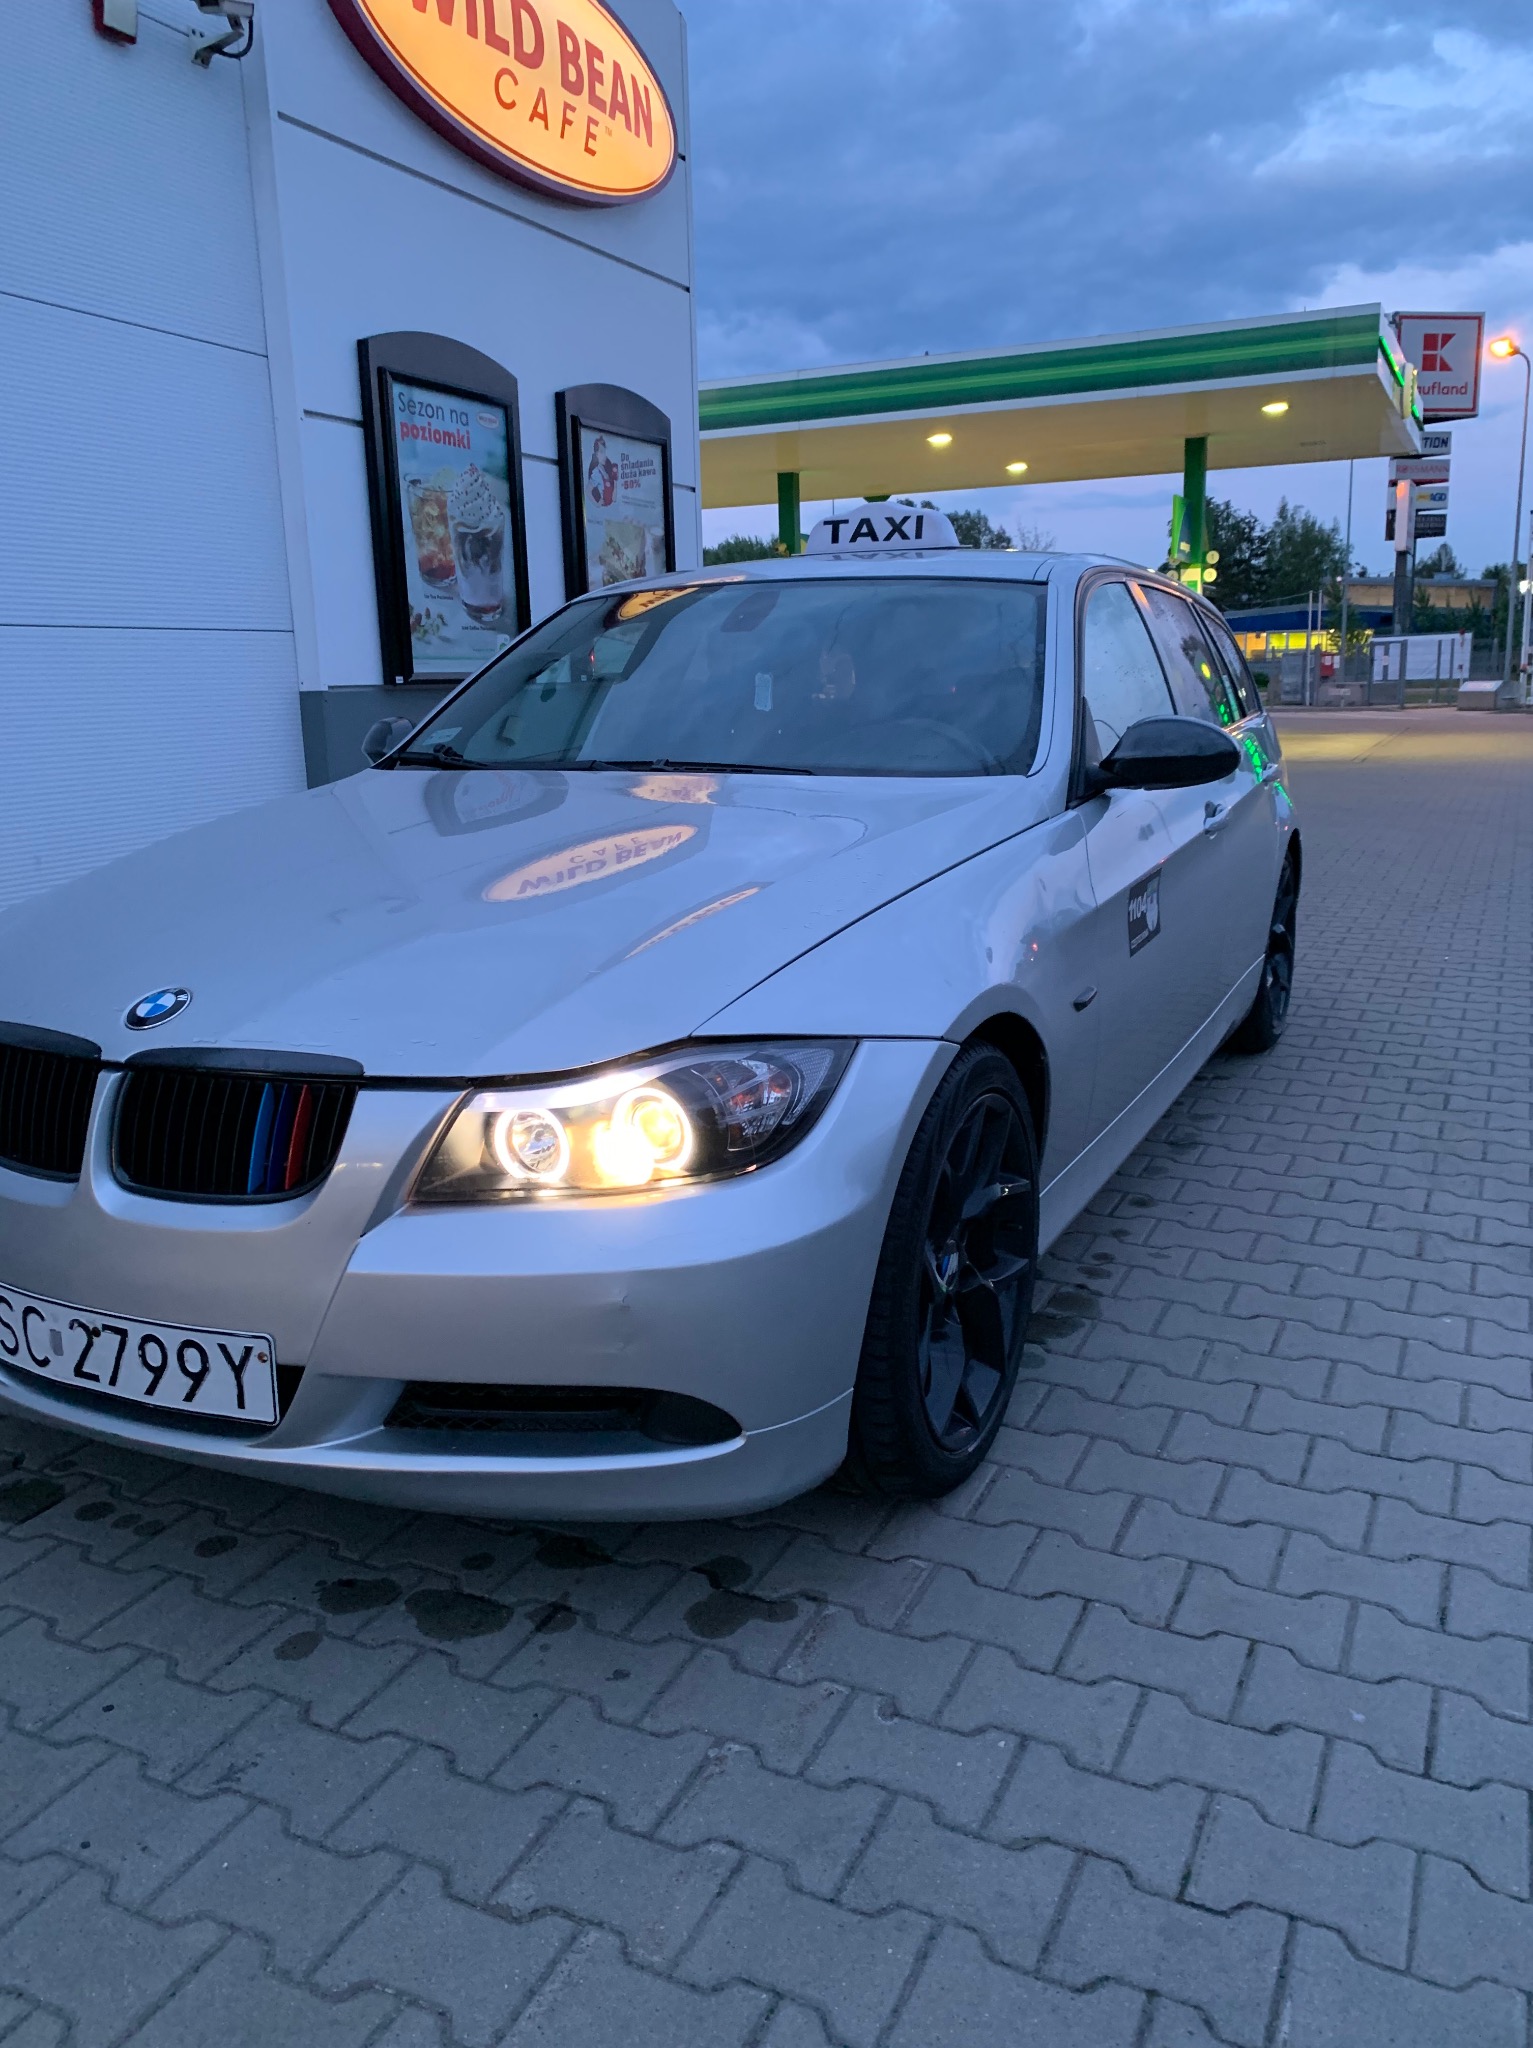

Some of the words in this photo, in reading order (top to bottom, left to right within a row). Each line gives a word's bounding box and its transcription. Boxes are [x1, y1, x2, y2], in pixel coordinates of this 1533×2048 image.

[411, 0, 545, 69] ILD
[557, 19, 653, 148] BEAN
[494, 67, 600, 157] CAFE
[397, 391, 445, 421] Sezon
[449, 407, 469, 427] na
[400, 421, 471, 449] poziomki
[1422, 436, 1449, 449] TION
[823, 515, 924, 544] TAXI
[68, 1318, 254, 1410] 2799Y
